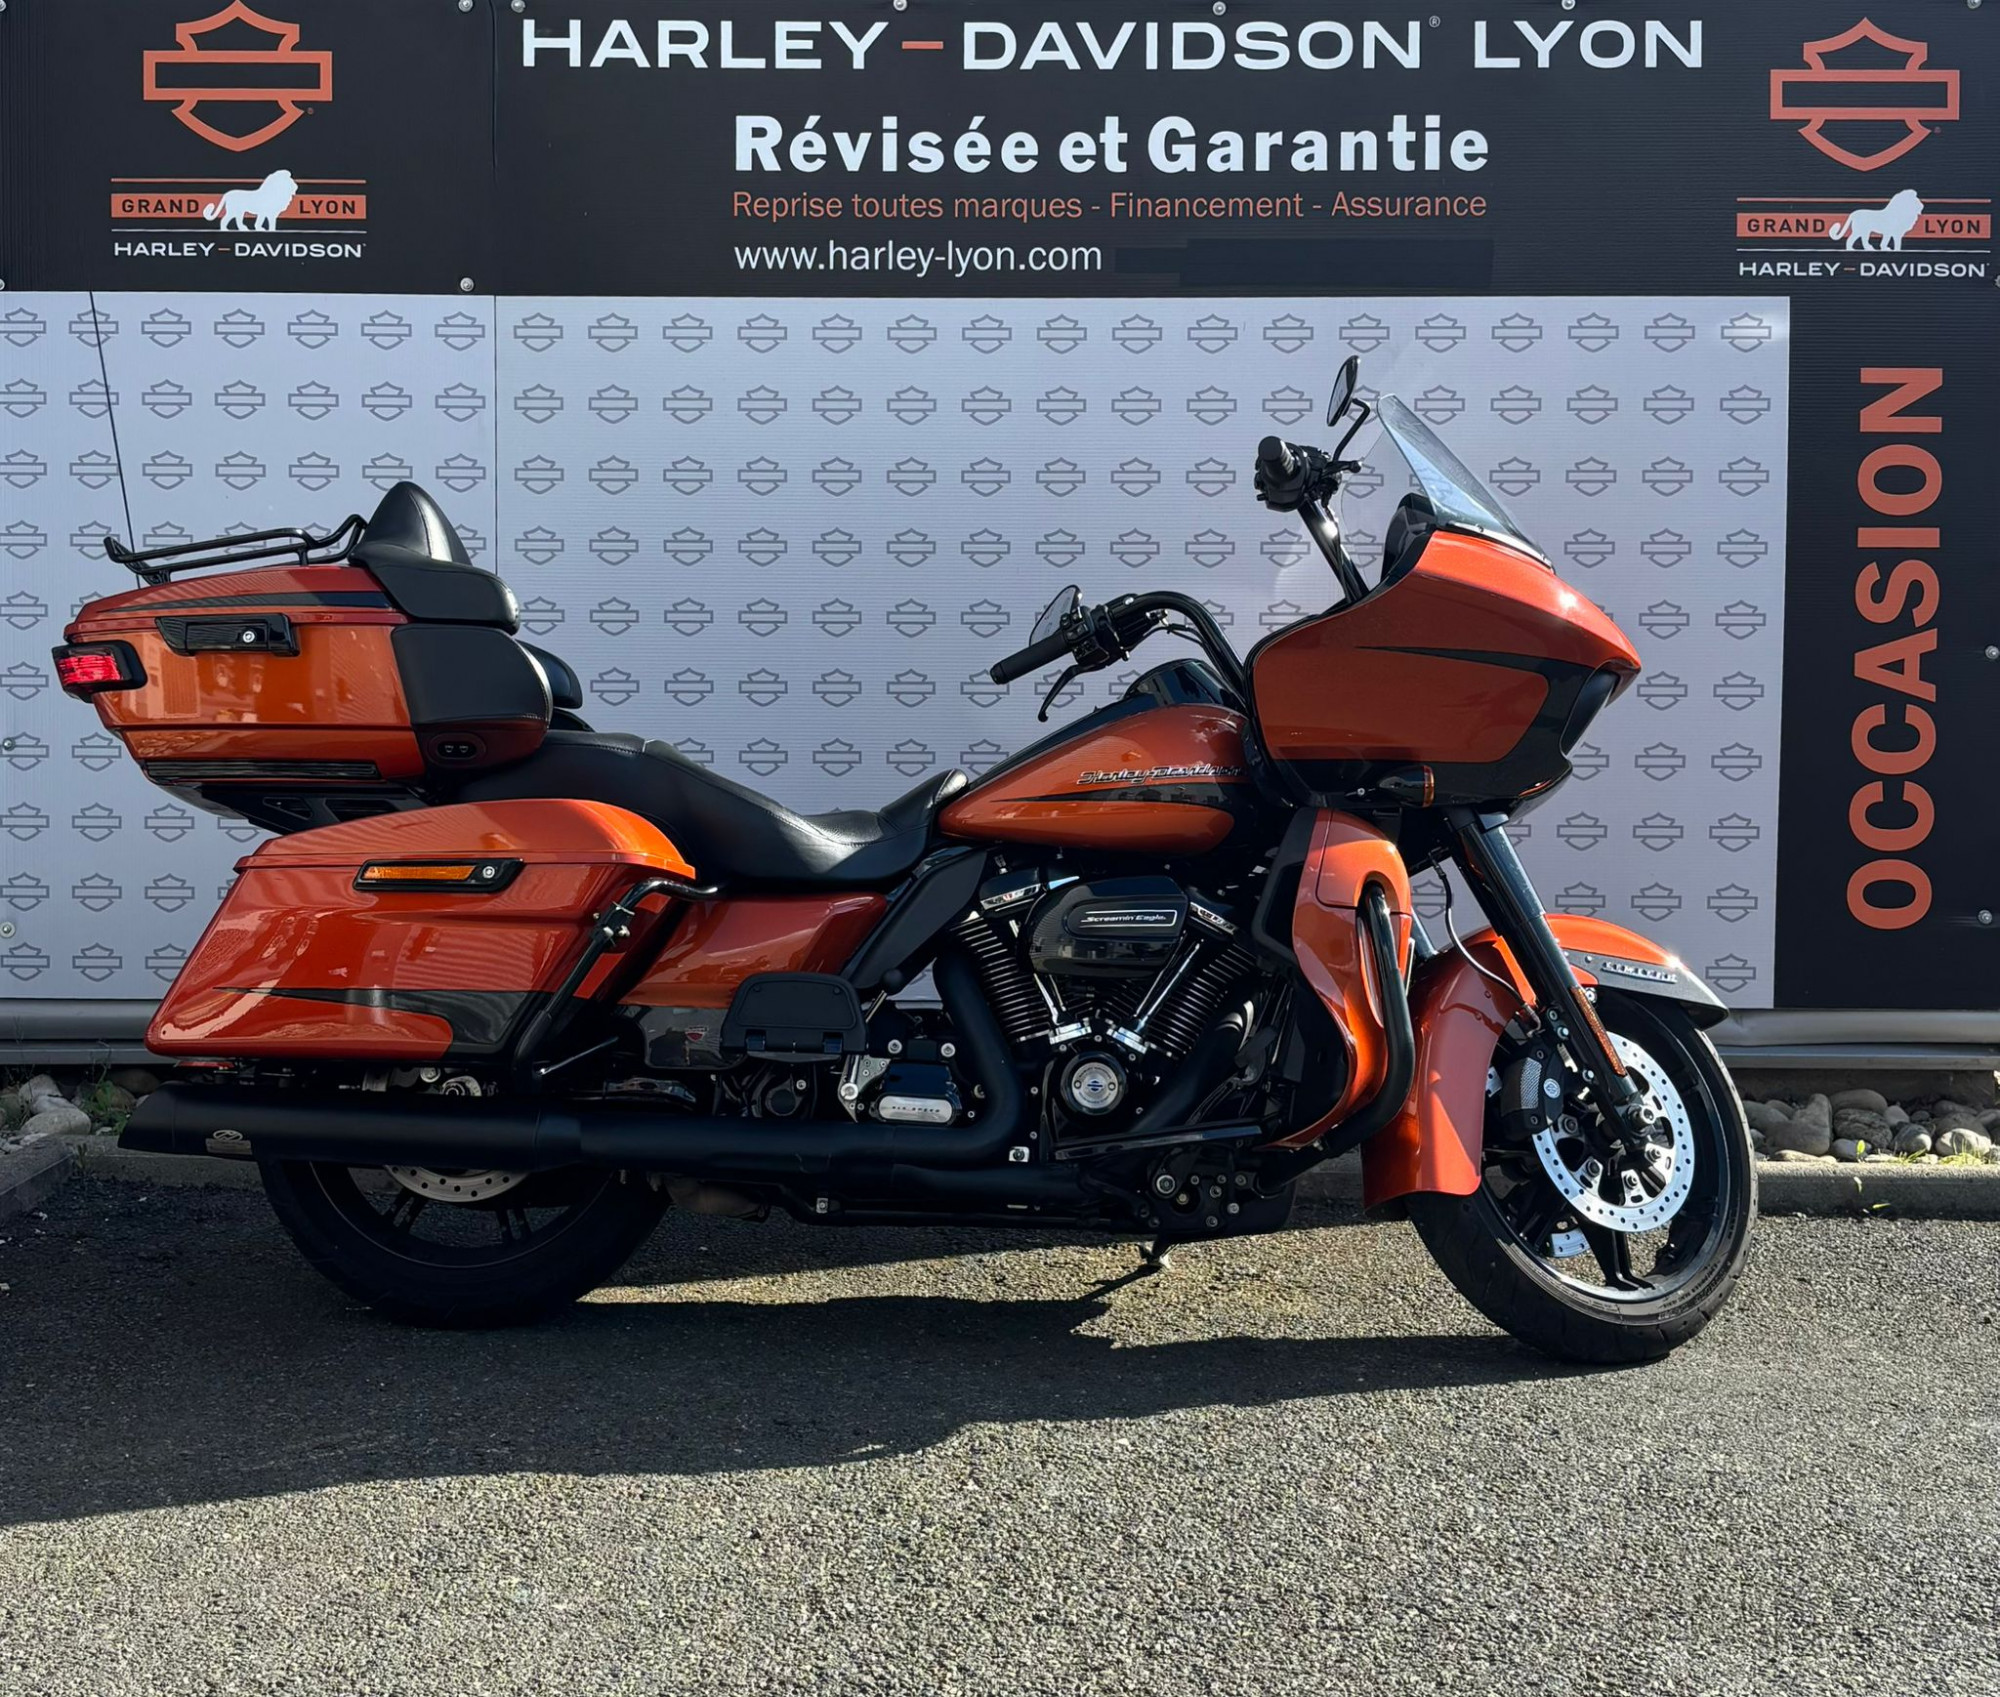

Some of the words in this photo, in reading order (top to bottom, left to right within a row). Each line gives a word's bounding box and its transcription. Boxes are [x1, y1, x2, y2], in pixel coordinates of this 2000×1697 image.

[1474, 19, 1703, 69] LYON
[735, 114, 1039, 174] Révisée
[1058, 115, 1128, 174] et
[1147, 114, 1489, 174] Garantie
[122, 199, 199, 214] GRAND
[299, 200, 356, 215] LYON
[733, 192, 843, 222] Reprise
[852, 194, 943, 218] toutes
[953, 198, 1083, 222] marques
[1110, 192, 1304, 218] Financement
[1331, 191, 1487, 218] Assurance
[1747, 218, 1826, 233] GRAND
[1924, 219, 1981, 234] LYON
[734, 239, 1102, 278] www.harley-lyon.com
[1846, 367, 1943, 931] OCCASION
